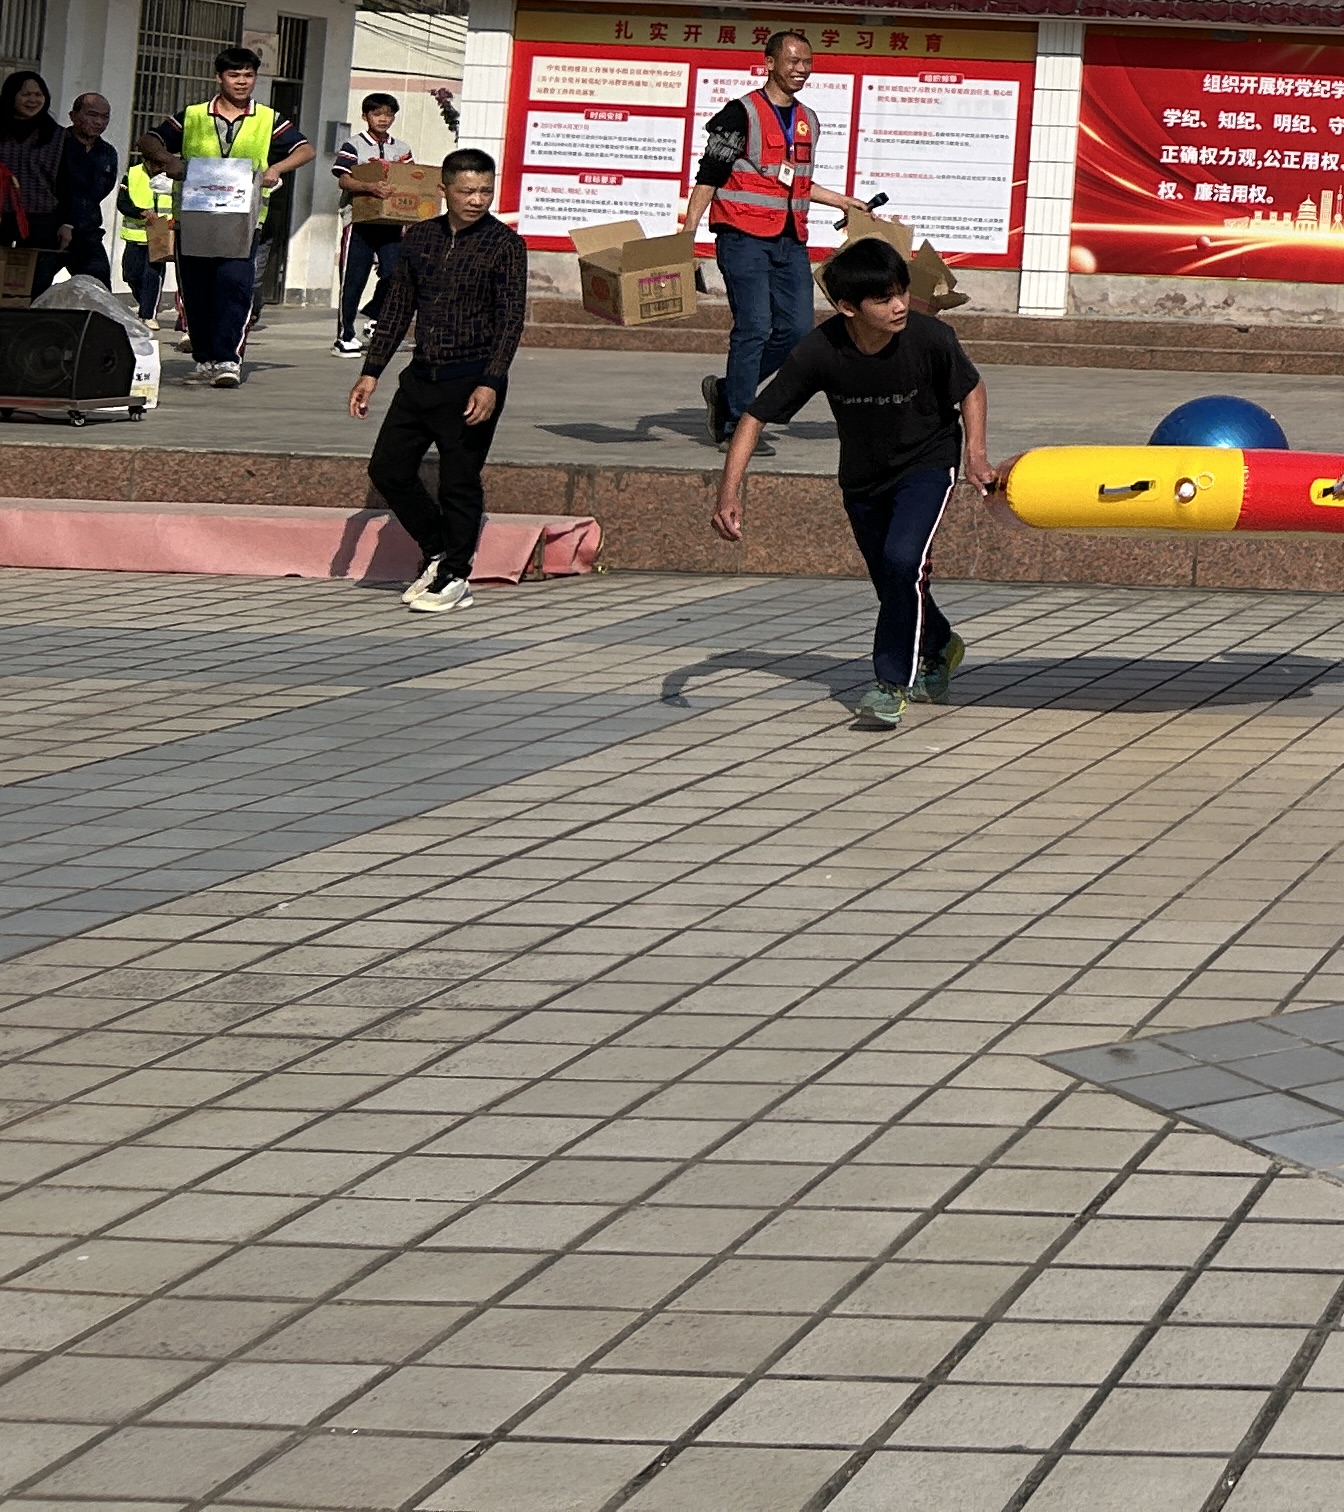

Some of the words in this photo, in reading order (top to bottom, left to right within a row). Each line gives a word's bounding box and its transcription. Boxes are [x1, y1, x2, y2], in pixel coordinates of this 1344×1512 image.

[1157, 179, 1277, 205] 权、廉洁用权。
